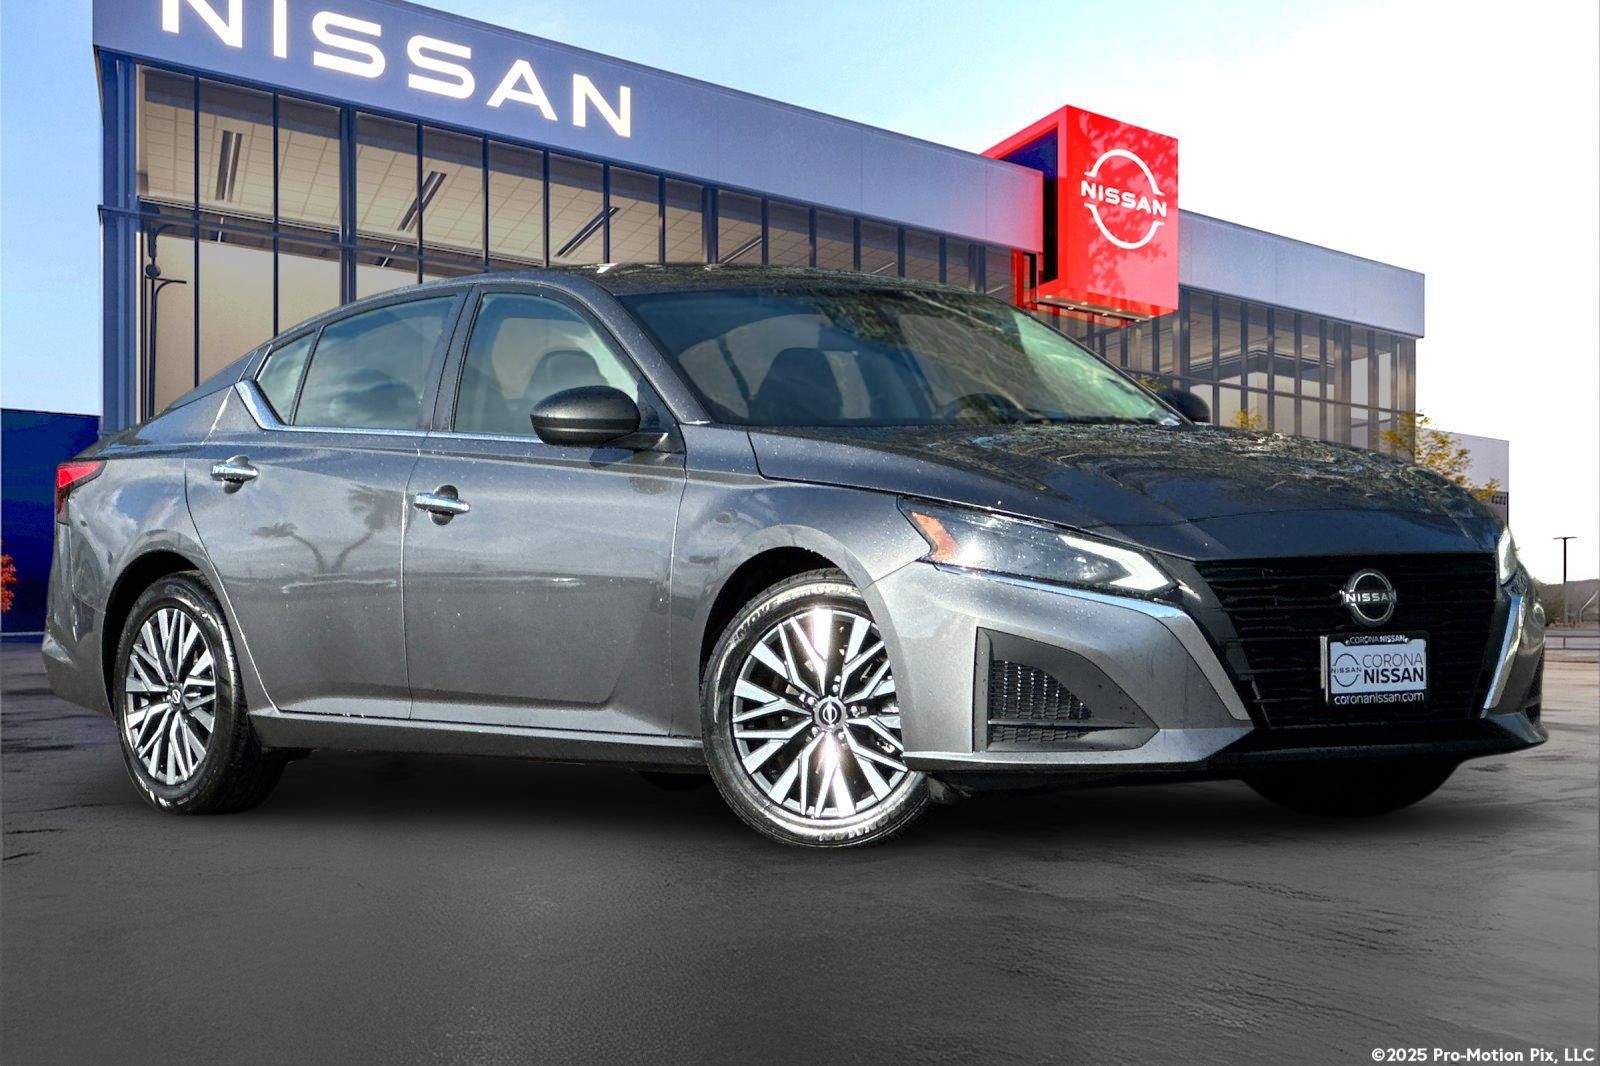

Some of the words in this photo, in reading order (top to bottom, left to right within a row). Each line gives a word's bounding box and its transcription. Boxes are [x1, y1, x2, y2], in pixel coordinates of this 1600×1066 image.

[162, 0, 631, 137] NISSAN
[1081, 180, 1168, 218] NISSAN
[1345, 592, 1397, 603] NISSAN
[1350, 636, 1379, 644] CORONA
[1380, 635, 1405, 643] NISSAN
[1362, 653, 1423, 668] CORONA
[1332, 666, 1362, 674] NISSAN
[1364, 667, 1424, 684] NISSAN
[1334, 691, 1424, 705] coronanissan.com
